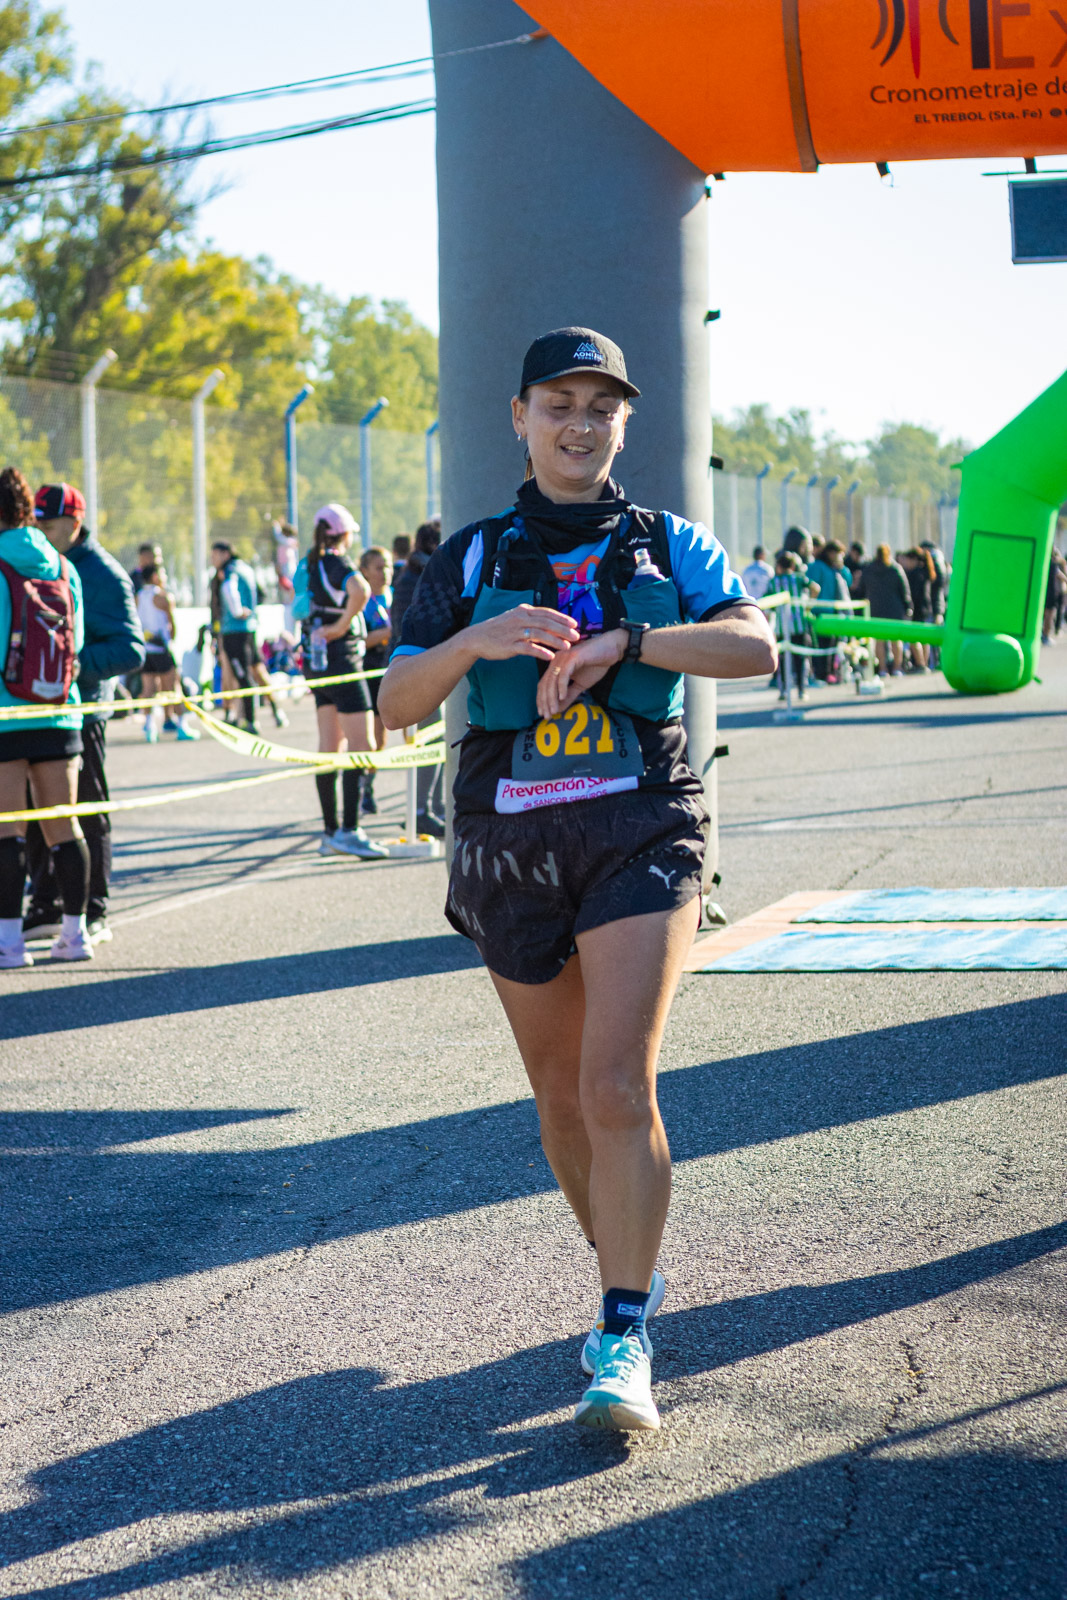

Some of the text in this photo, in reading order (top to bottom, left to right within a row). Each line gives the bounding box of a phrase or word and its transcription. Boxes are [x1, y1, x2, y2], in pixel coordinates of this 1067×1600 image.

[870, 79, 1038, 103] Cronometraje
[914, 108, 1043, 124] EL TREBOL (Sta. Fe)
[535, 703, 614, 757] 627
[502, 777, 585, 799] Prevención
[523, 801, 532, 809] de
